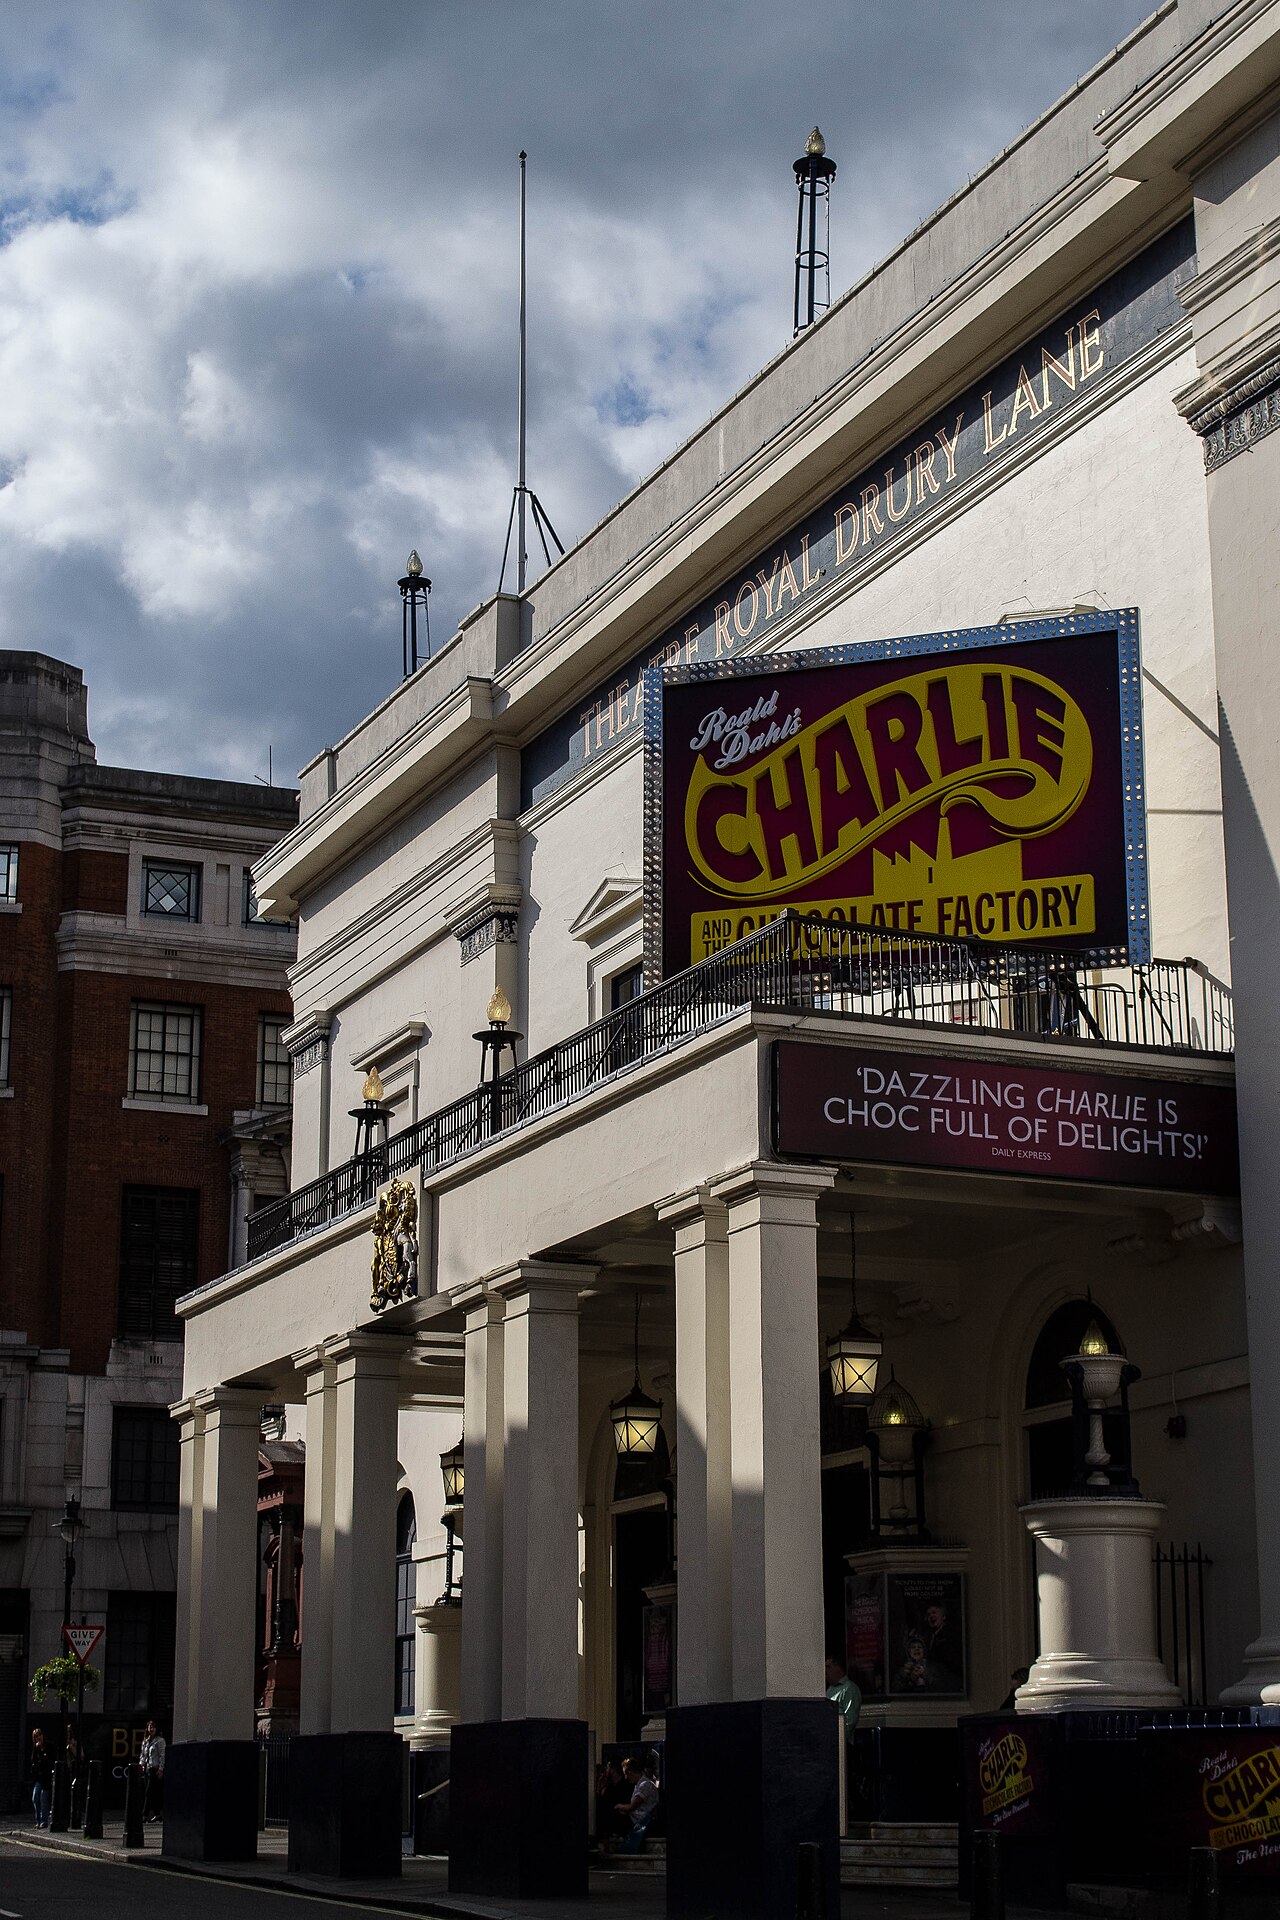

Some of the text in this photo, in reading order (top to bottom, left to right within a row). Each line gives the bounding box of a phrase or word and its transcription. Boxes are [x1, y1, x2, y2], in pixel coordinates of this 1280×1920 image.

[713, 533, 822, 660] ROYAL
[833, 411, 965, 567] DRURY
[981, 307, 1105, 456] LANE
[689, 690, 780, 751] Roald
[714, 706, 802, 770] Dahl's
[695, 673, 1067, 883] CHARLIE
[702, 919, 732, 940] AND
[937, 883, 1082, 936] FACTORY
[823, 1097, 921, 1132] CHOC
[930, 1108, 999, 1142] FULL
[1007, 1116, 1049, 1144] OF
[1036, 1086, 1148, 1123] CHARLIE
[1157, 1099, 1179, 1125] IS
[991, 1147, 1052, 1161] DAILY EXPRESS
[70, 1630, 95, 1639] GIVE
[981, 1736, 1024, 1789] CHARLIE
[1199, 1750, 1228, 1774] Roald
[1236, 1848, 1258, 1865] The
